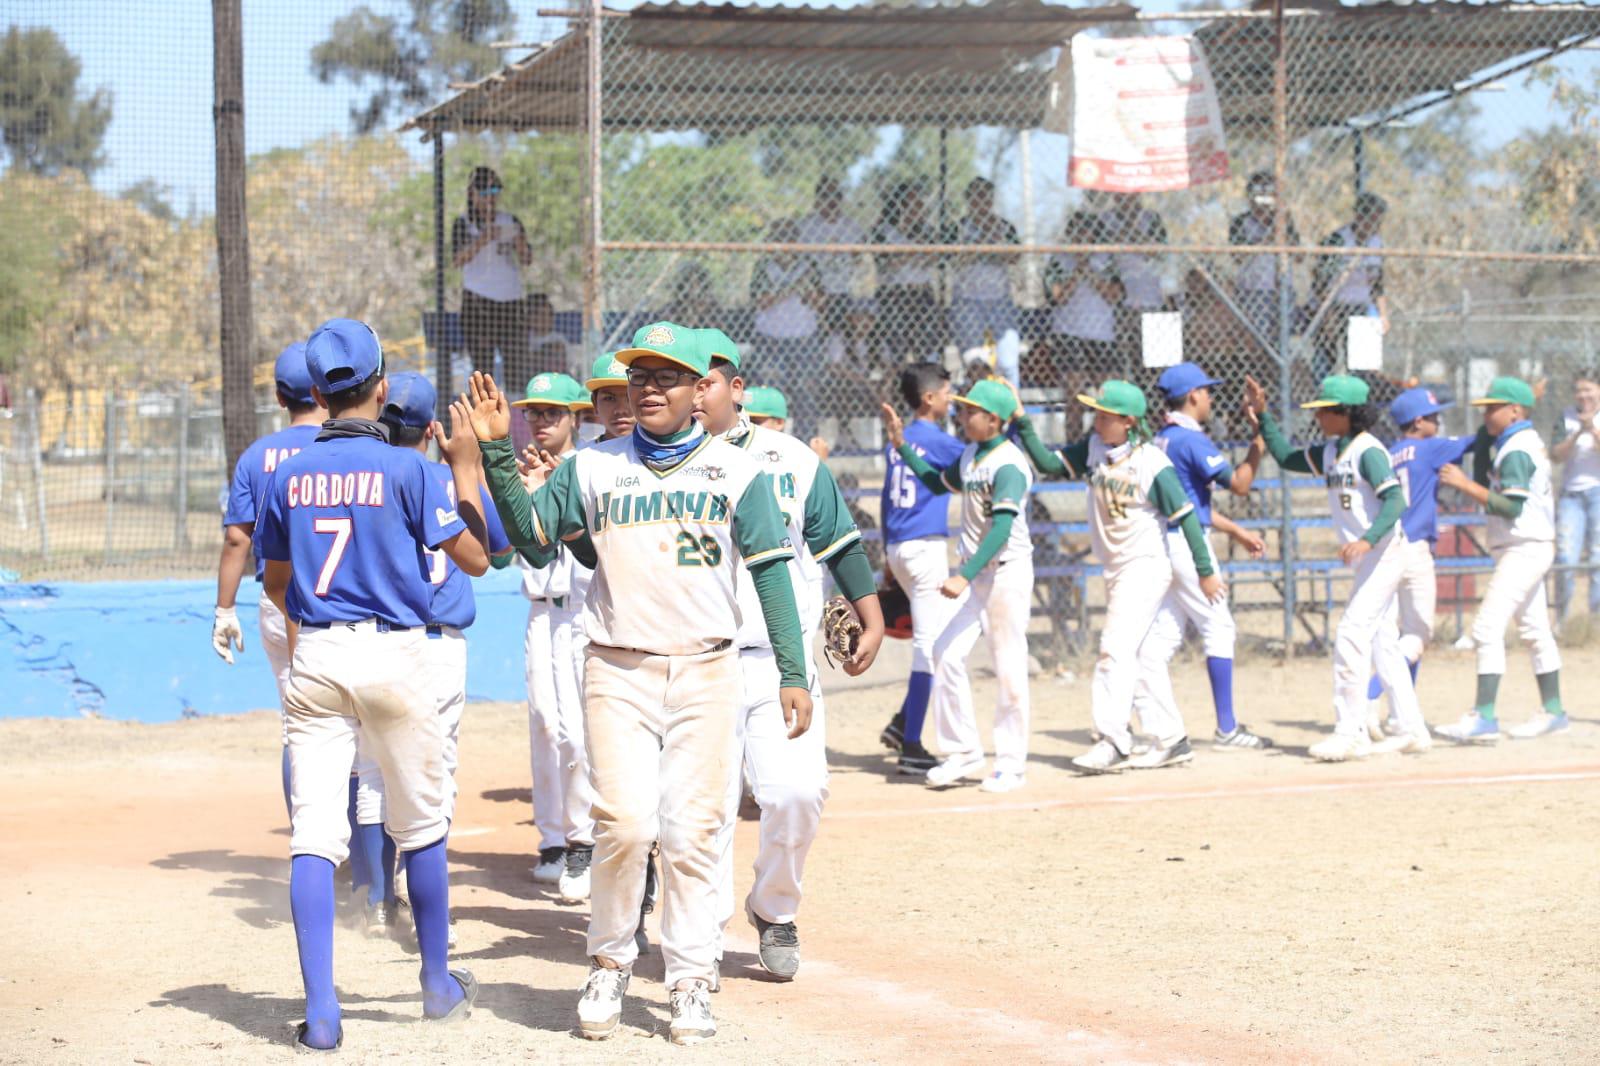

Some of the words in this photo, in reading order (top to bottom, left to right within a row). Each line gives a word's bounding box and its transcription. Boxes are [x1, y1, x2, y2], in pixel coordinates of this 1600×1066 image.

[288, 471, 384, 507] CORDOVA
[615, 475, 641, 488] LIGA
[594, 490, 731, 534] HUMAYA
[313, 517, 352, 597] 7
